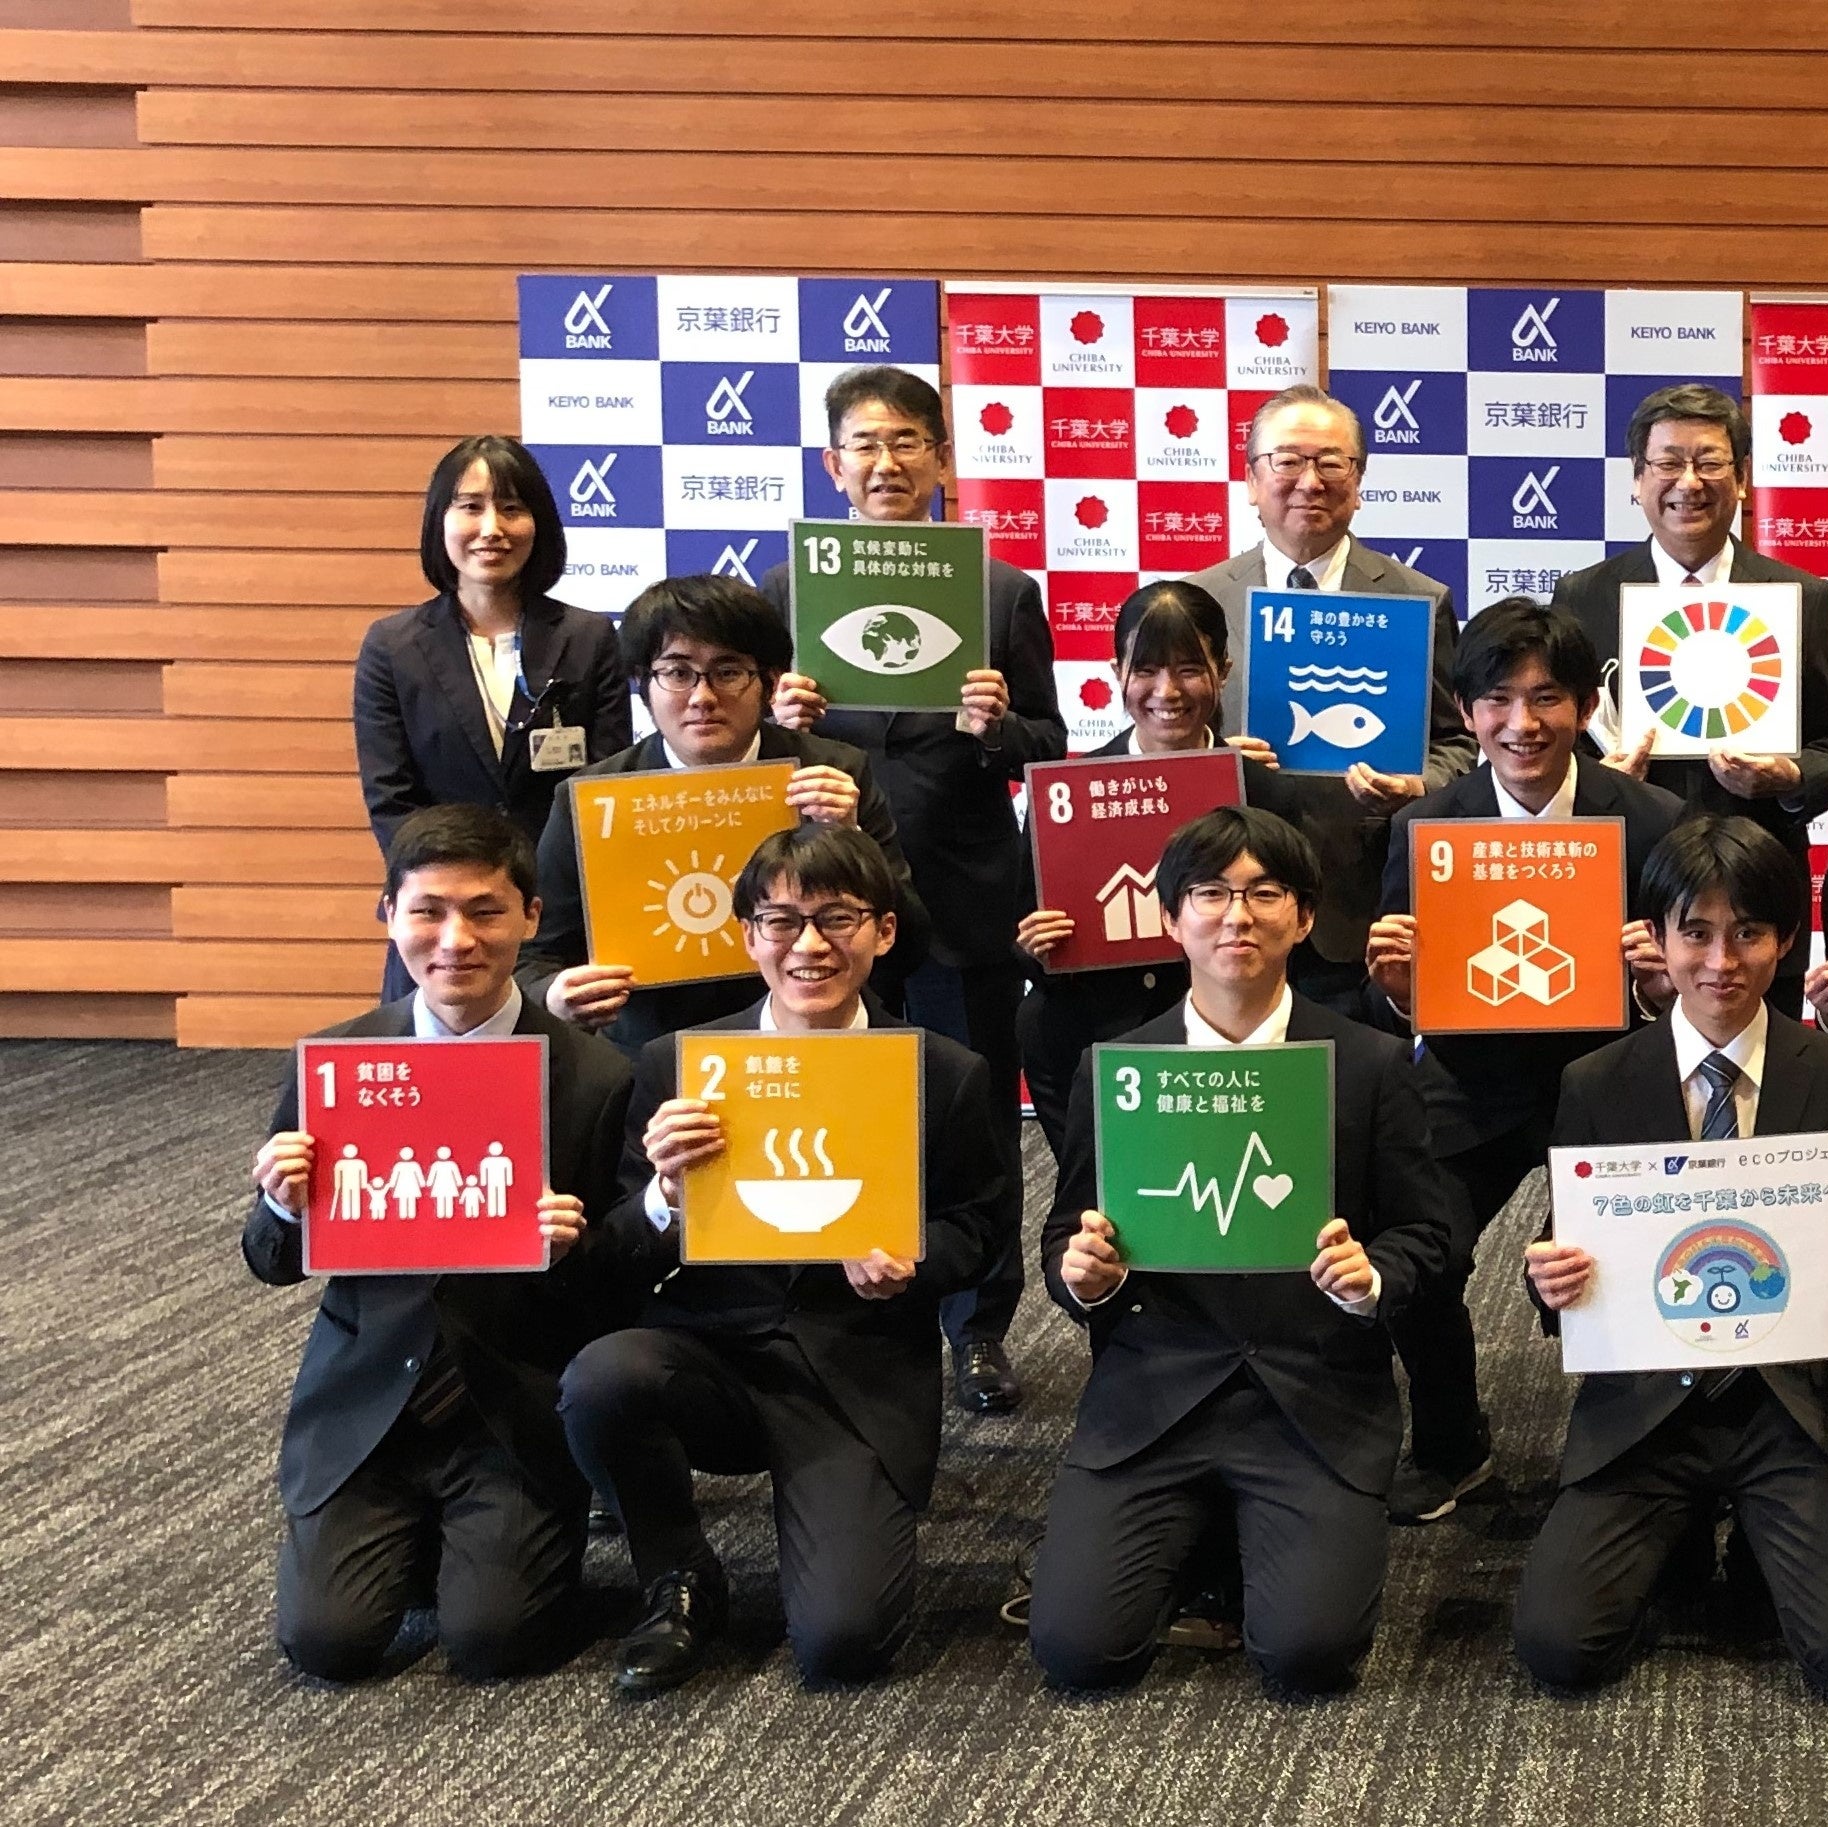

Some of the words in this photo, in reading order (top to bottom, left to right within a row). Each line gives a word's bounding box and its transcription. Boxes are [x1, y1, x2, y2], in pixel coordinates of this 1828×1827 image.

[677, 306, 780, 333] 京葉銀行
[1354, 322, 1395, 334] KEIYO
[1401, 323, 1440, 335] BANK
[956, 325, 1034, 346] 千葉大学
[1142, 328, 1219, 348] 千葉大学
[1631, 326, 1671, 339] KEIYO
[1677, 327, 1715, 339] BANK
[566, 335, 612, 349] BANK
[845, 338, 891, 352] BANK
[1069, 354, 1105, 362] CHIBA
[1254, 357, 1291, 365] CHIBA
[1513, 348, 1558, 362] BANK
[1052, 363, 1122, 372] UNIVERSITY
[1238, 366, 1308, 375] UNIVERSITY
[548, 396, 590, 408] KEIYO
[596, 396, 634, 409] BANK
[1485, 402, 1588, 429] 京葉銀行
[707, 421, 753, 435] BANK
[1051, 419, 1129, 439] 千葉大学
[1375, 430, 1420, 444] BANK
[1164, 448, 1200, 457] CHIBA
[1777, 454, 1812, 463] CHIBA
[1148, 458, 1217, 467] UNIVERSITY
[681, 476, 784, 501] 京葉銀行
[1403, 491, 1441, 502] BANK
[571, 504, 616, 517] BANK
[1145, 512, 1222, 532] 千葉大学
[1513, 516, 1558, 529] BANK
[852, 539, 927, 557] 気候変動に
[1074, 538, 1110, 547] CHIBA
[804, 536, 841, 575] 13
[1057, 548, 1127, 557] UNIVERSITY
[563, 564, 594, 575] EIYO
[601, 565, 639, 575] BANK
[853, 560, 954, 578] 具体的な対策を
[1485, 569, 1577, 593] 京葉銀
[1260, 606, 1295, 642] 14
[1310, 610, 1388, 628] 海の豊かさを
[1310, 630, 1348, 646] 守ろう
[1079, 720, 1114, 728] CHIBA
[1089, 775, 1168, 797] 働きがいも
[631, 785, 774, 813] エネルギーをみんなに
[1050, 782, 1073, 823] 8
[1091, 796, 1169, 819] 経済成長も
[594, 796, 615, 839] 7
[634, 812, 742, 836] そしてクリーンに
[1472, 841, 1597, 859] 産業と技術革新の
[1430, 840, 1453, 882] 9
[1472, 863, 1576, 880] 基盤をつくろう
[356, 1062, 411, 1082] 貧困を
[700, 1054, 726, 1100] 2
[1157, 1070, 1260, 1088] すべての人に
[316, 1061, 336, 1107] 1
[746, 1080, 800, 1098] ゼロに
[1116, 1067, 1141, 1111] 3
[358, 1087, 421, 1107] なくそう
[1157, 1094, 1265, 1113] 健康と福祉を
[1595, 1161, 1641, 1172] 千葉大学
